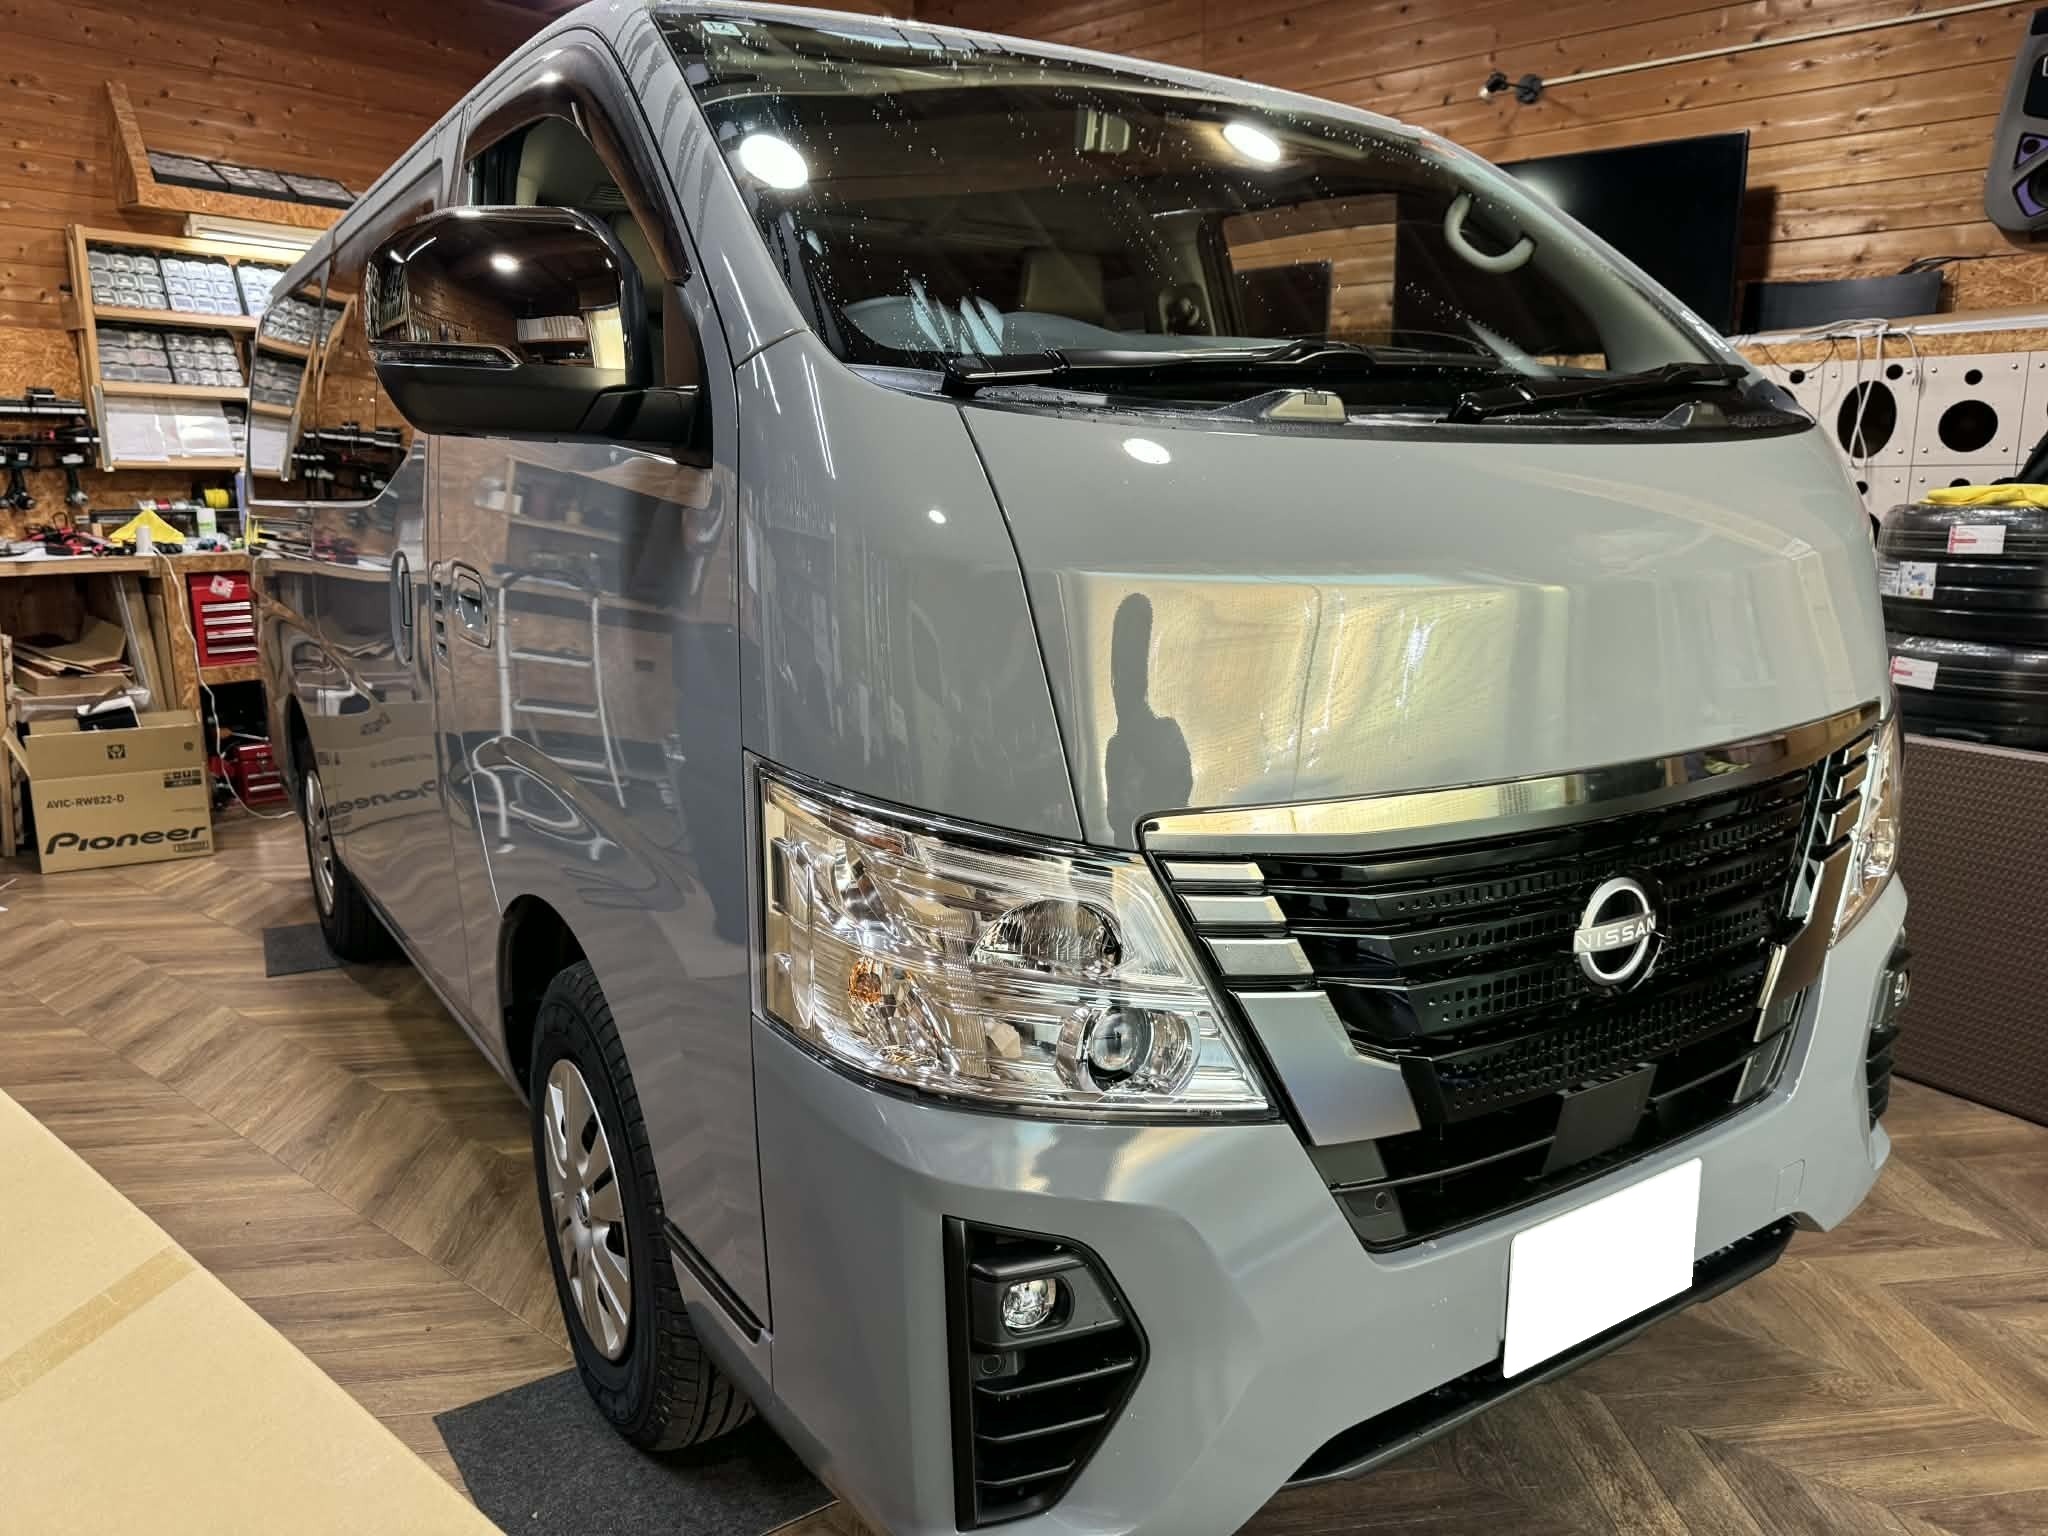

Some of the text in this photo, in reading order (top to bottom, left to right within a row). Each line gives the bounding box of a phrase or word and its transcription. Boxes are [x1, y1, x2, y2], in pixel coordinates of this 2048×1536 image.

[46, 794, 125, 809] AVIC-RW822-D
[45, 826, 207, 855] Pioneer
[1575, 915, 1656, 949] NISSAN
